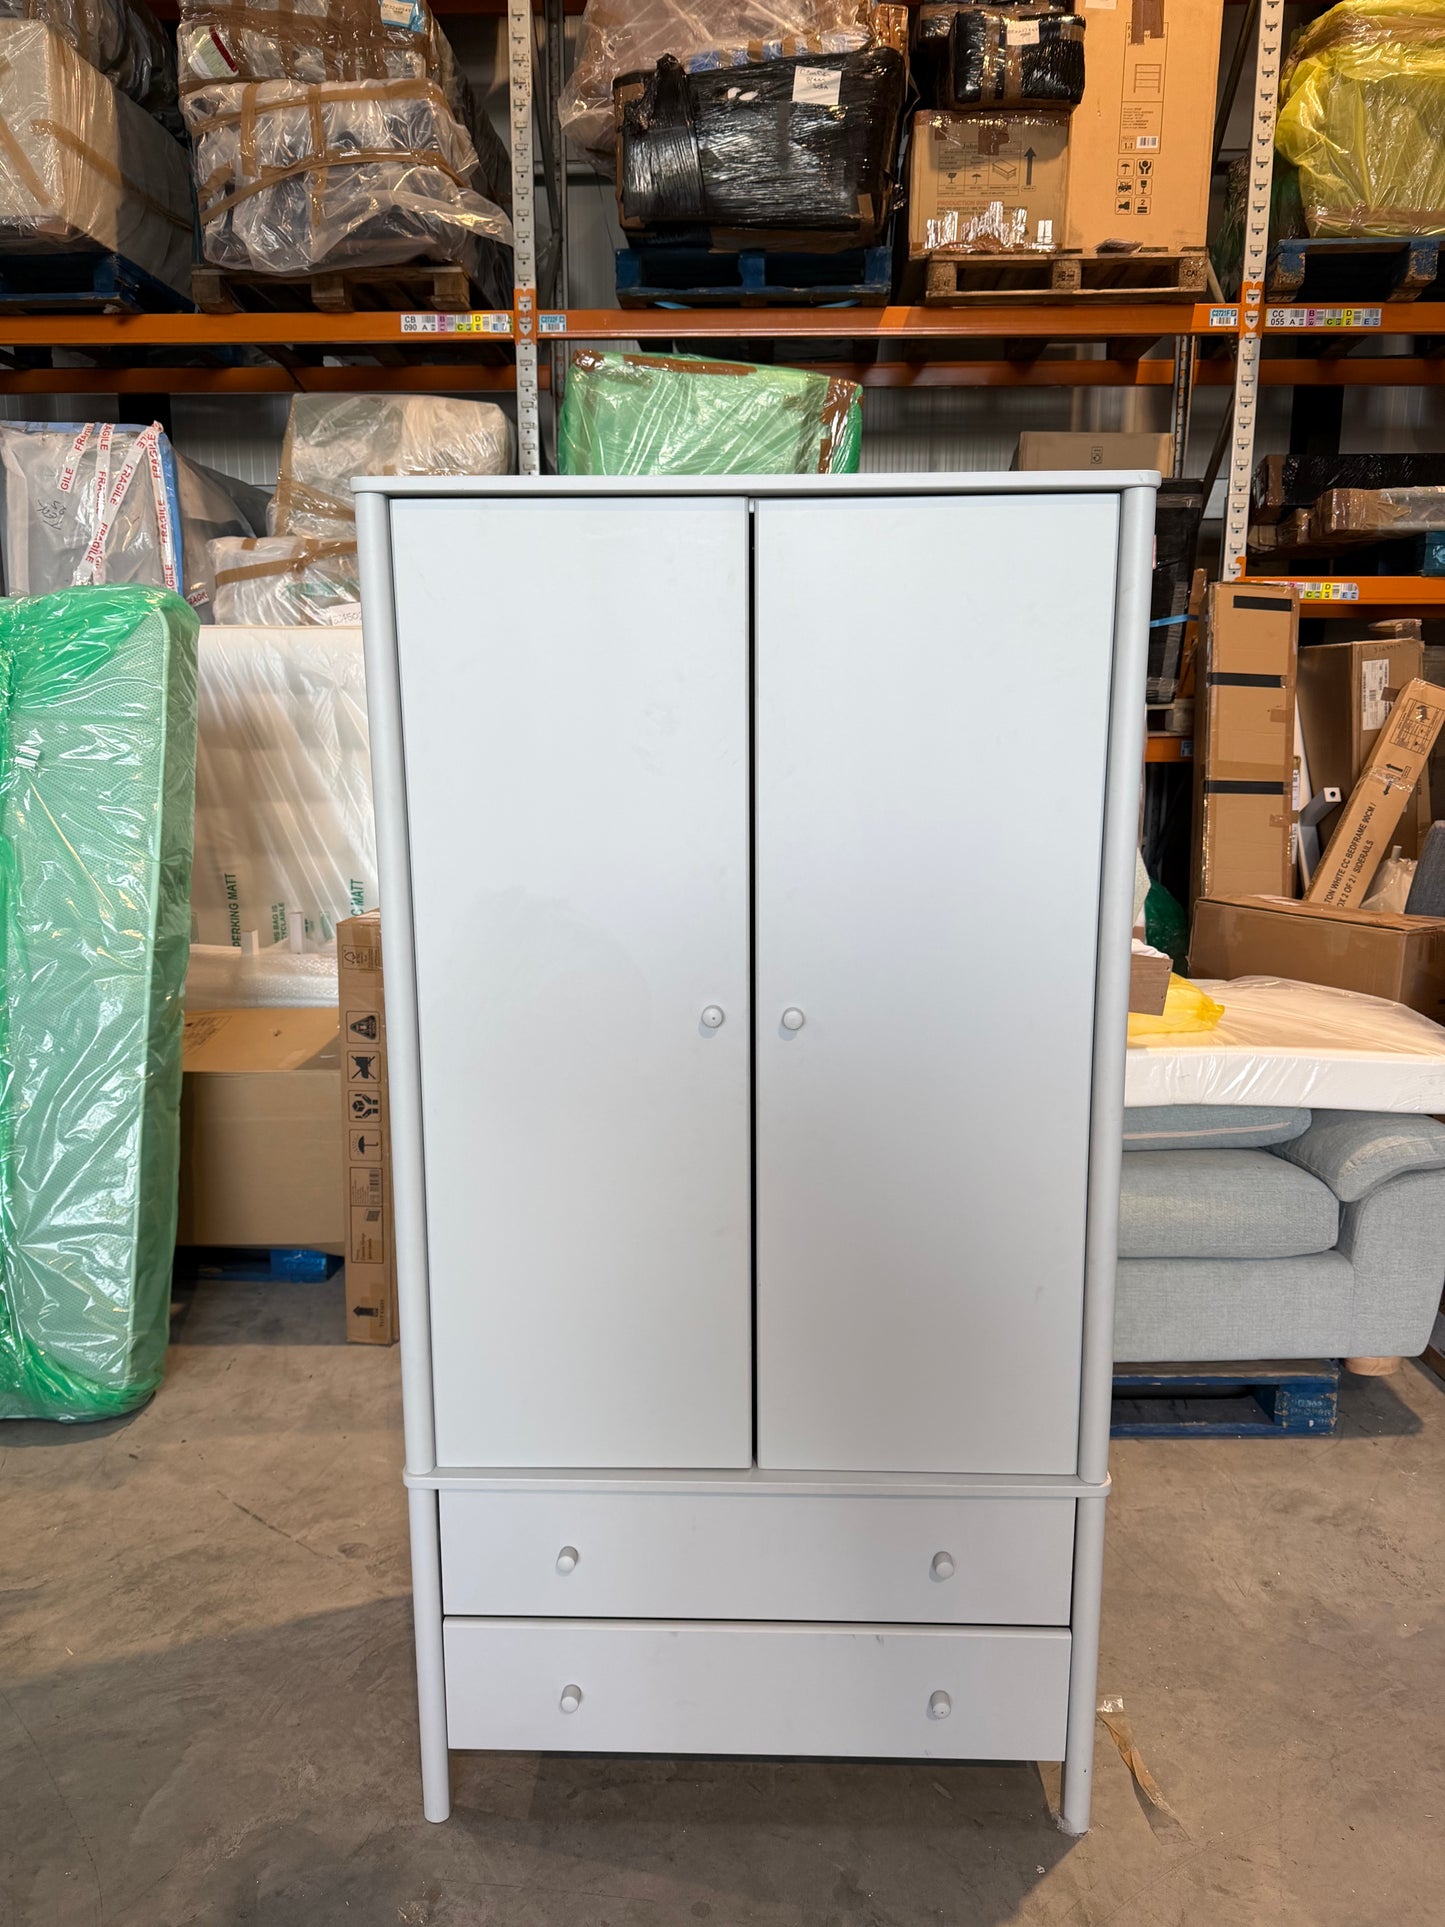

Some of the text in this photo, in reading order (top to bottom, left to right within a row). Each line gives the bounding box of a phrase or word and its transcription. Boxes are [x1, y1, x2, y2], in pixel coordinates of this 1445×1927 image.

[404, 315, 417, 324] CB
[1270, 318, 1285, 326] 055
[1289, 318, 1296, 326] A
[1272, 310, 1285, 318] CC
[1308, 309, 1315, 317] B
[403, 323, 418, 331] 090
[60, 467, 74, 490] GILE
[110, 463, 134, 506] FRAGILE
[157, 500, 169, 544] FRAGILE
[87, 522, 108, 563] FRAGILE
[1345, 823, 1368, 859] BEDFRAME
[1341, 856, 1352, 870] CC
[1353, 839, 1375, 874] SIDERAILS
[224, 873, 238, 900] MATT
[1331, 868, 1347, 891] WHITE
[350, 879, 364, 906] MATT
[1323, 889, 1336, 904] TON
